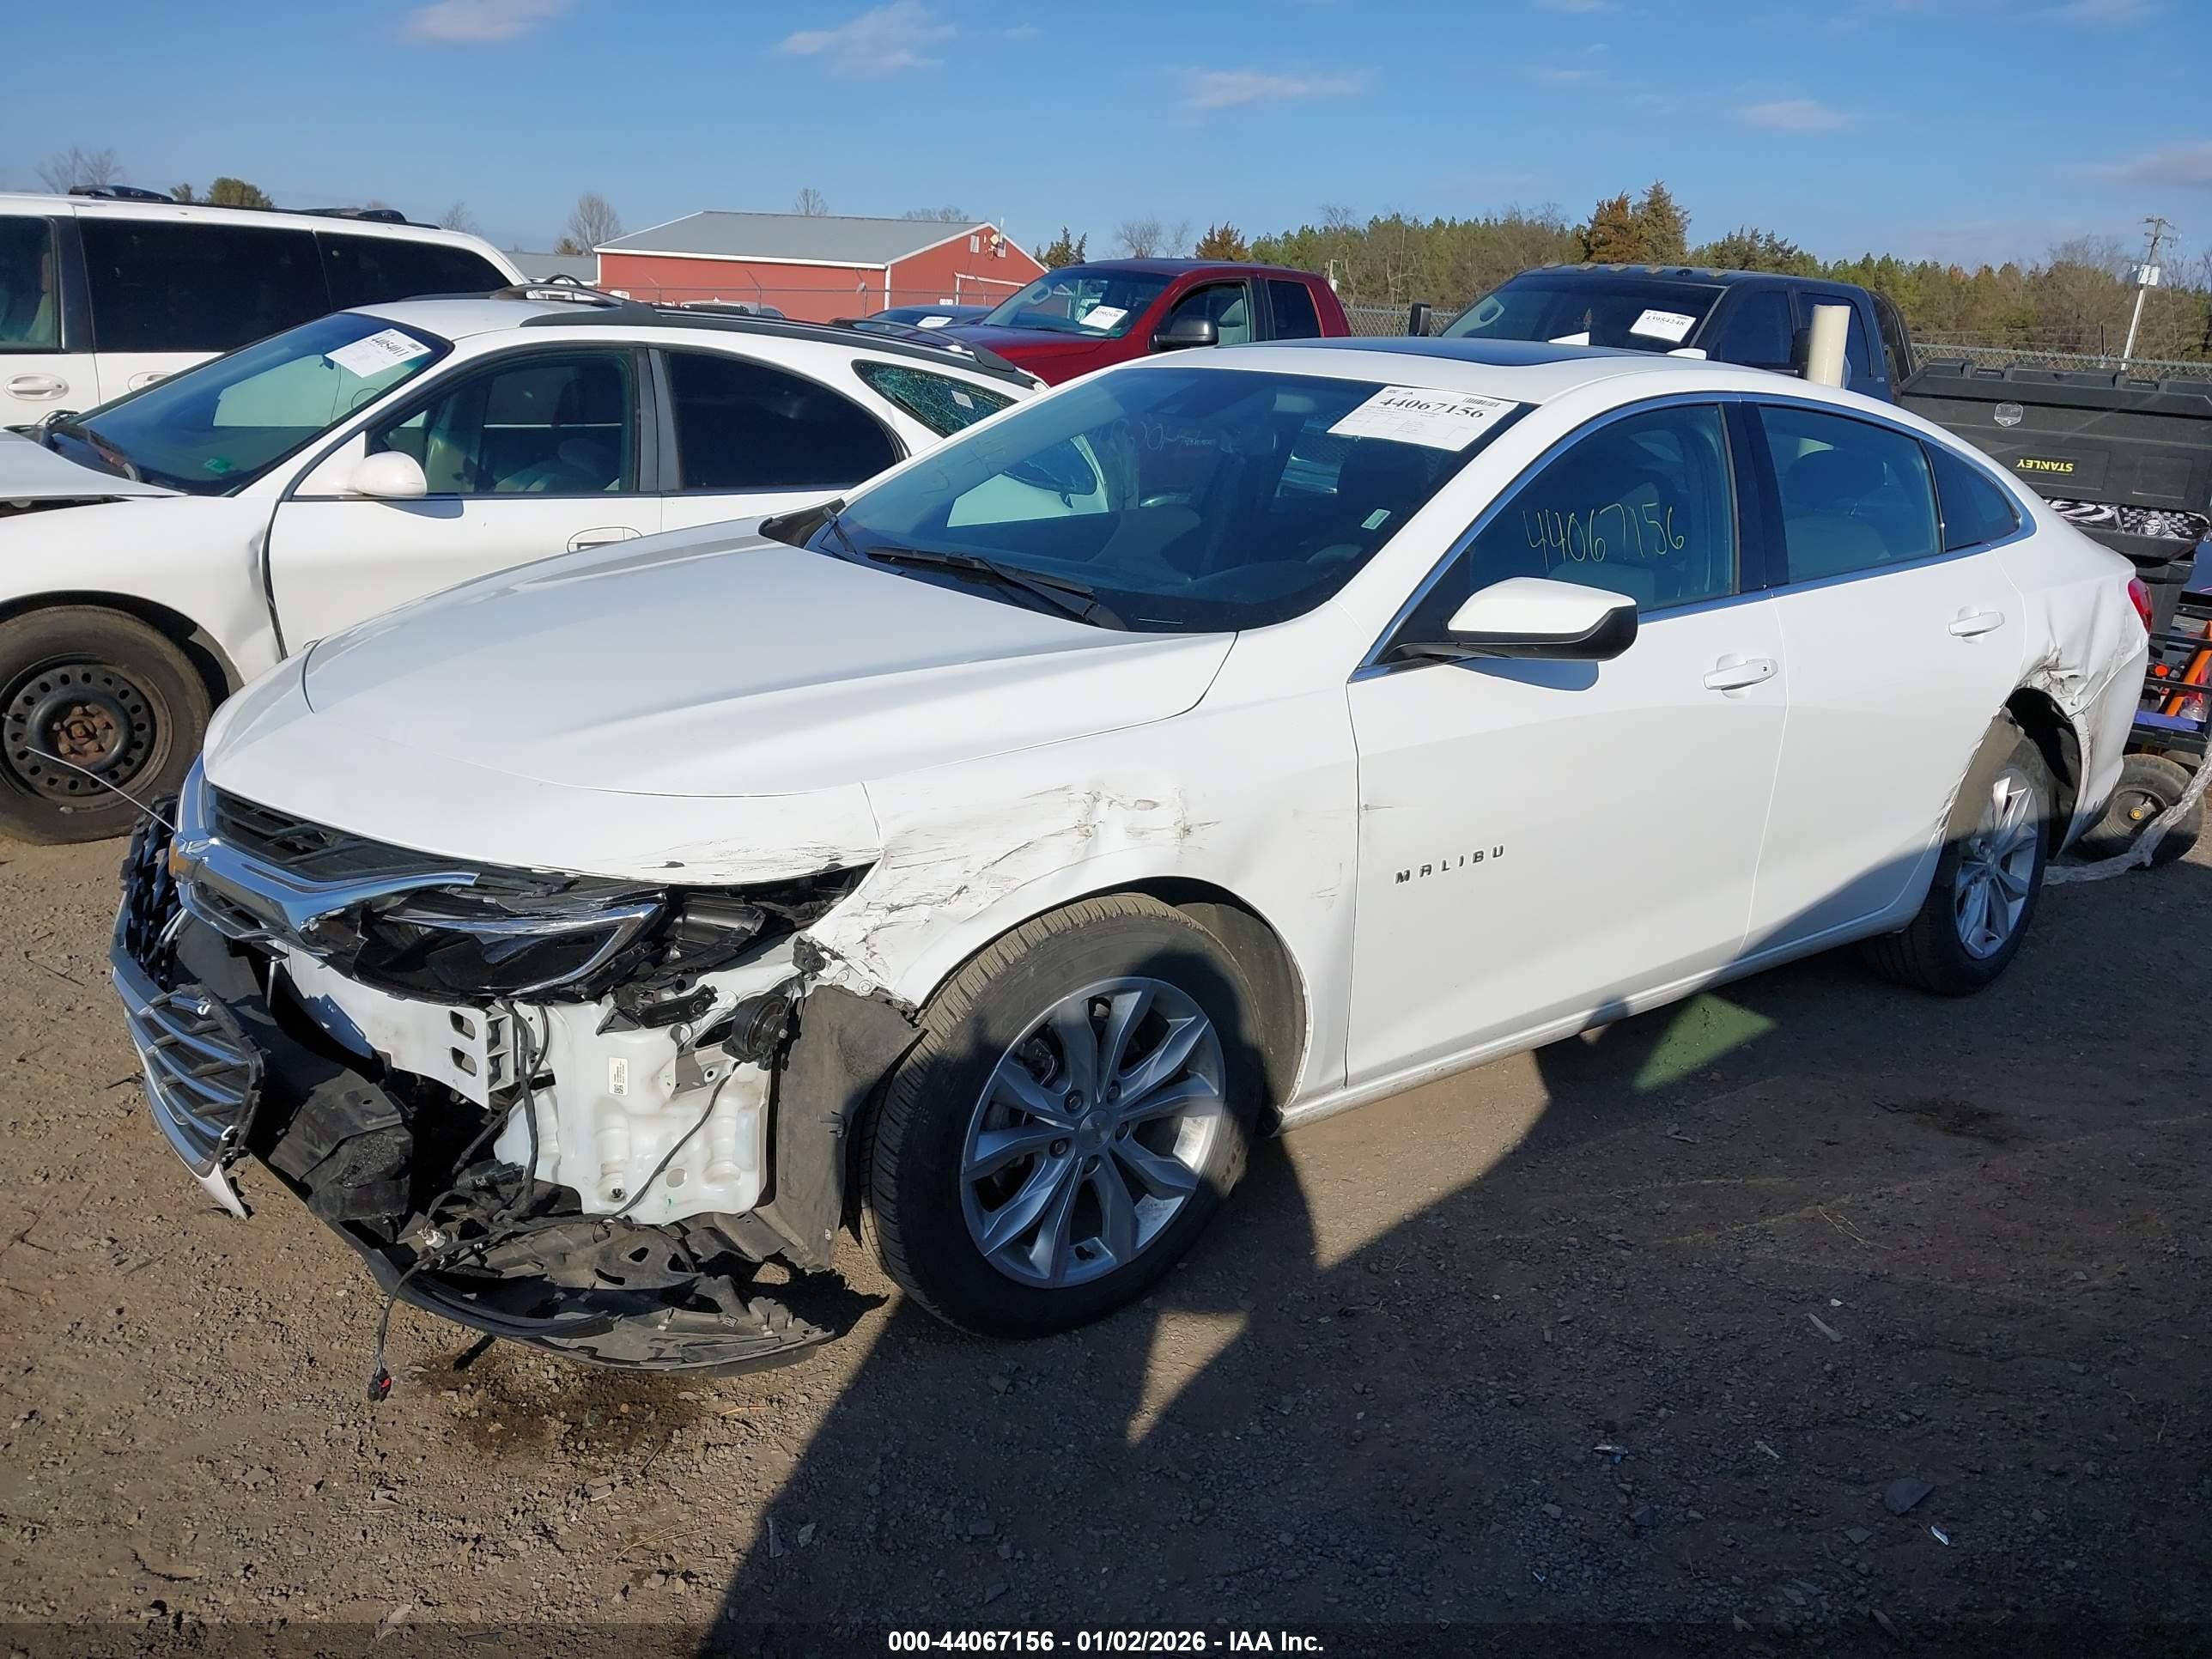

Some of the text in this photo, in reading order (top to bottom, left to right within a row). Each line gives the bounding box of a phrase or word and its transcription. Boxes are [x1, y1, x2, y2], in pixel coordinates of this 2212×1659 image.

[1380, 397, 1486, 418] 44067156
[2017, 459, 2074, 472] STANLEY
[1522, 501, 1685, 574] 44067156
[1395, 845, 1504, 884] MALIBU
